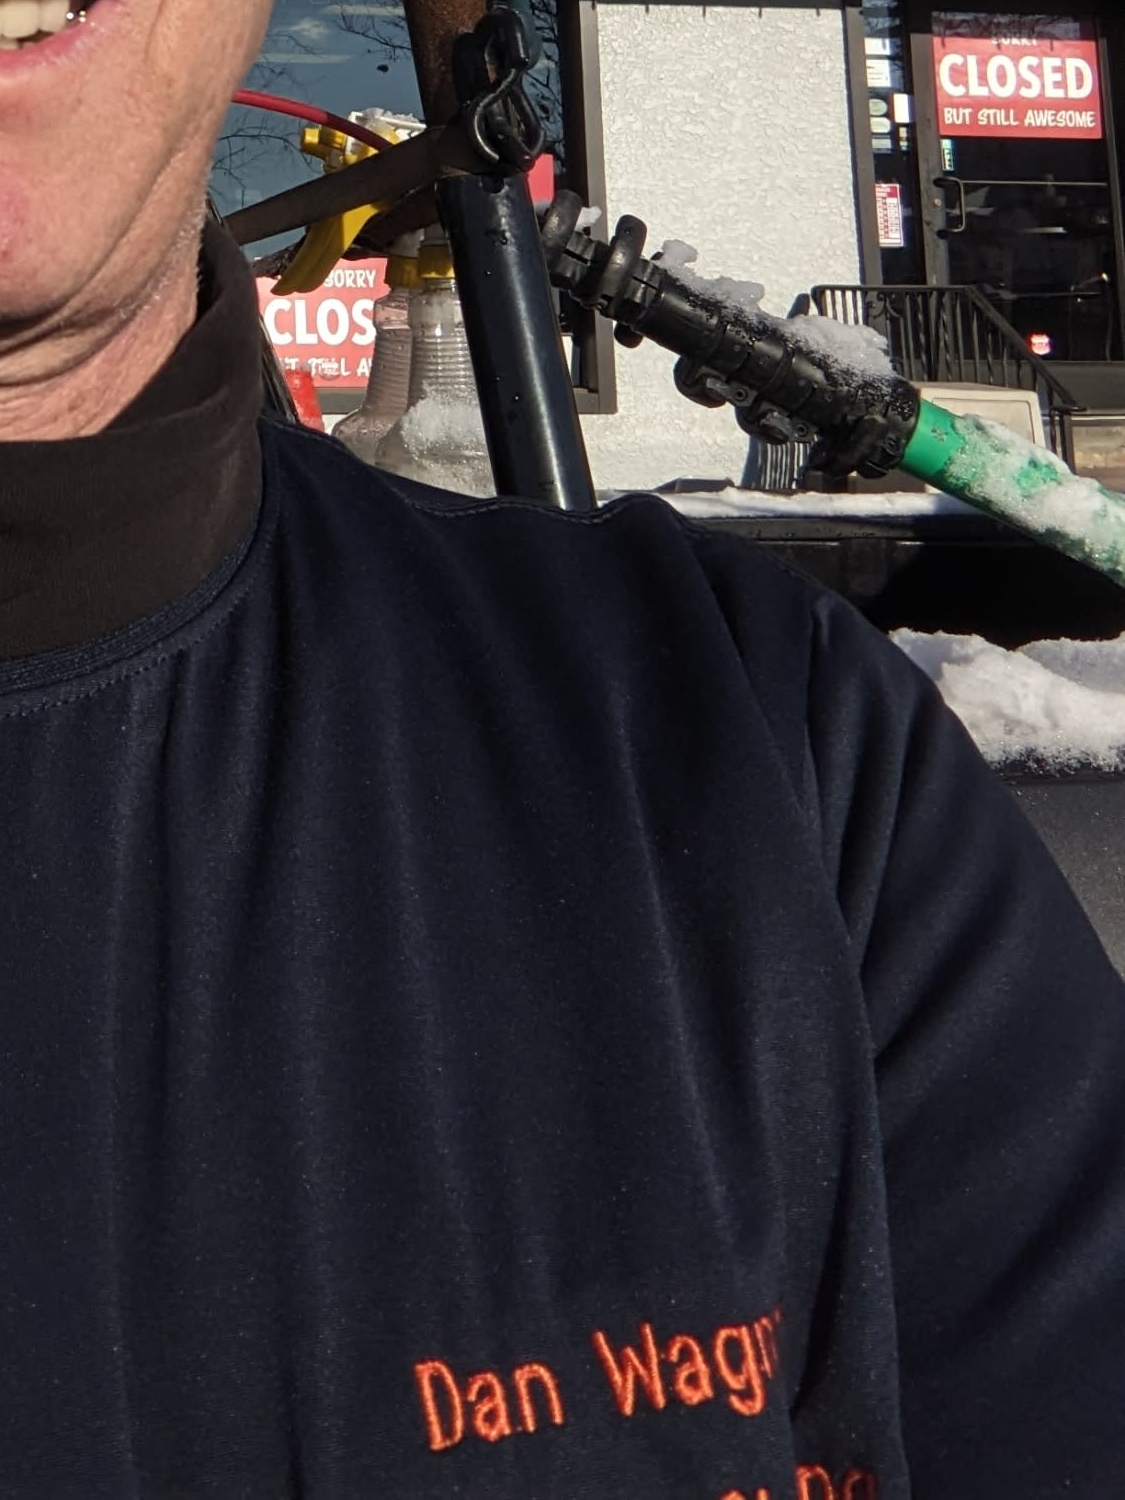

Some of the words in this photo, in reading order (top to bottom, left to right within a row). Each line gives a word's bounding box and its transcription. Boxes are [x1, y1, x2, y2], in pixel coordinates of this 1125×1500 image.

[939, 53, 1093, 99] CLOSED
[943, 107, 972, 125] BUT
[977, 108, 1019, 126] STILL
[1024, 109, 1096, 128] AWESOME
[414, 1359, 565, 1452] Dan
